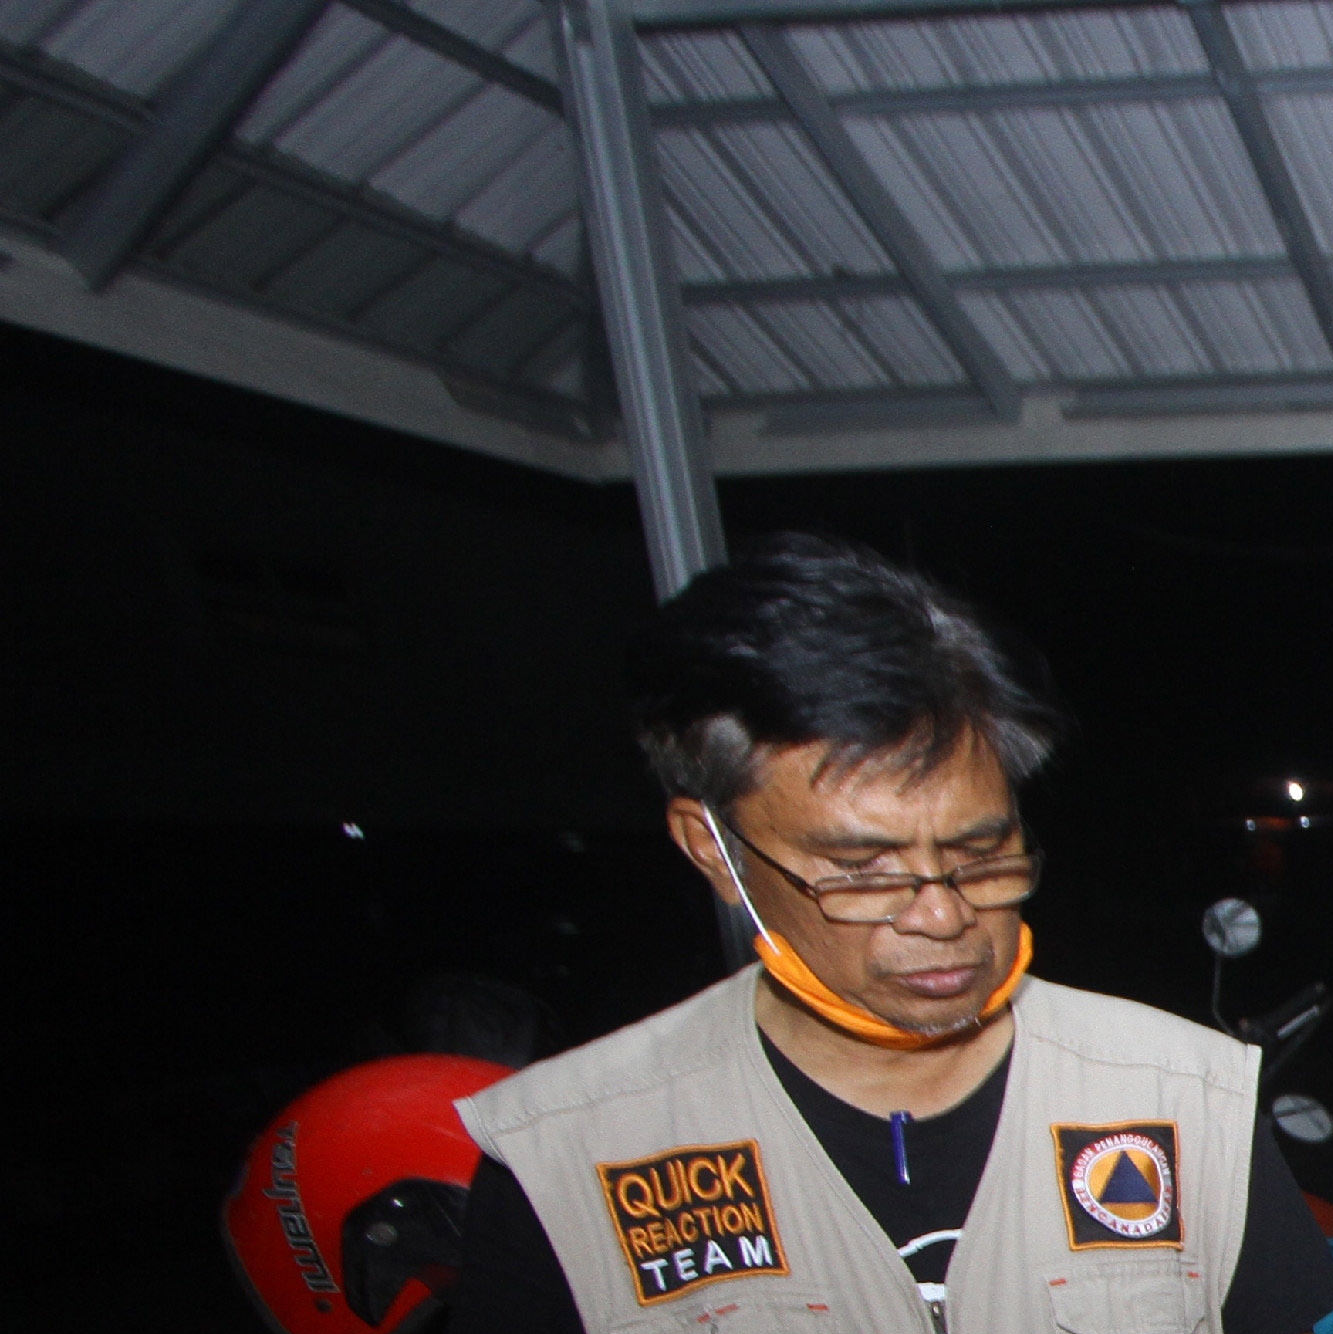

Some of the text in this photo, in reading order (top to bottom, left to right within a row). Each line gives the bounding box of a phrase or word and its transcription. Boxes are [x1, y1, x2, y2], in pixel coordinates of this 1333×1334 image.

[617, 1153, 754, 1220] QUICK
[629, 1202, 765, 1258] REACTION
[641, 1235, 772, 1291] TEAM
